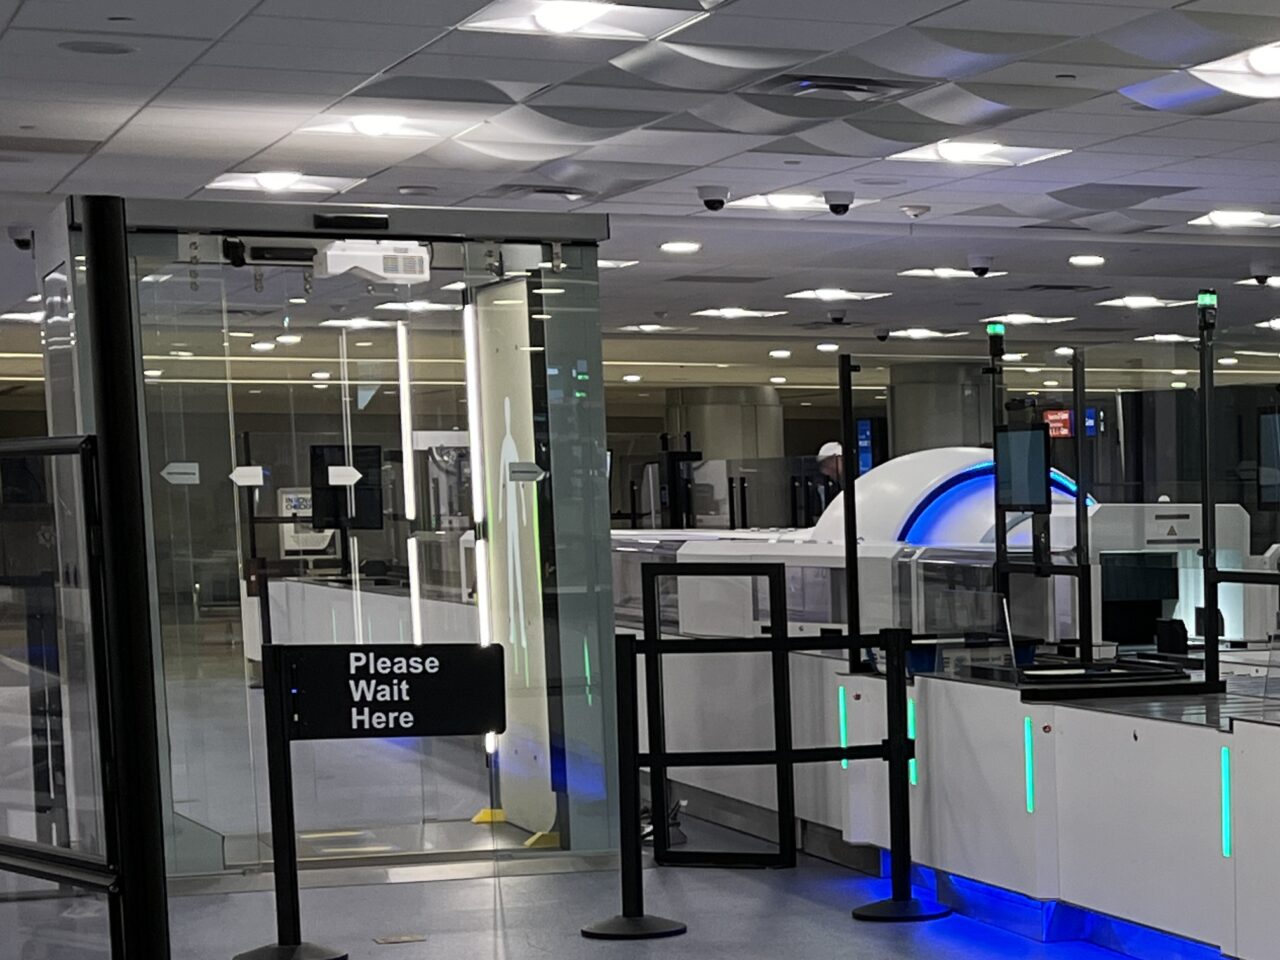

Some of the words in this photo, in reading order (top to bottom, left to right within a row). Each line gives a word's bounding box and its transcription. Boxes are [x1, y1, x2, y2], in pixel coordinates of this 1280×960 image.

[349, 652, 440, 674] Please
[349, 679, 410, 702] Wait
[351, 707, 414, 729] Here
